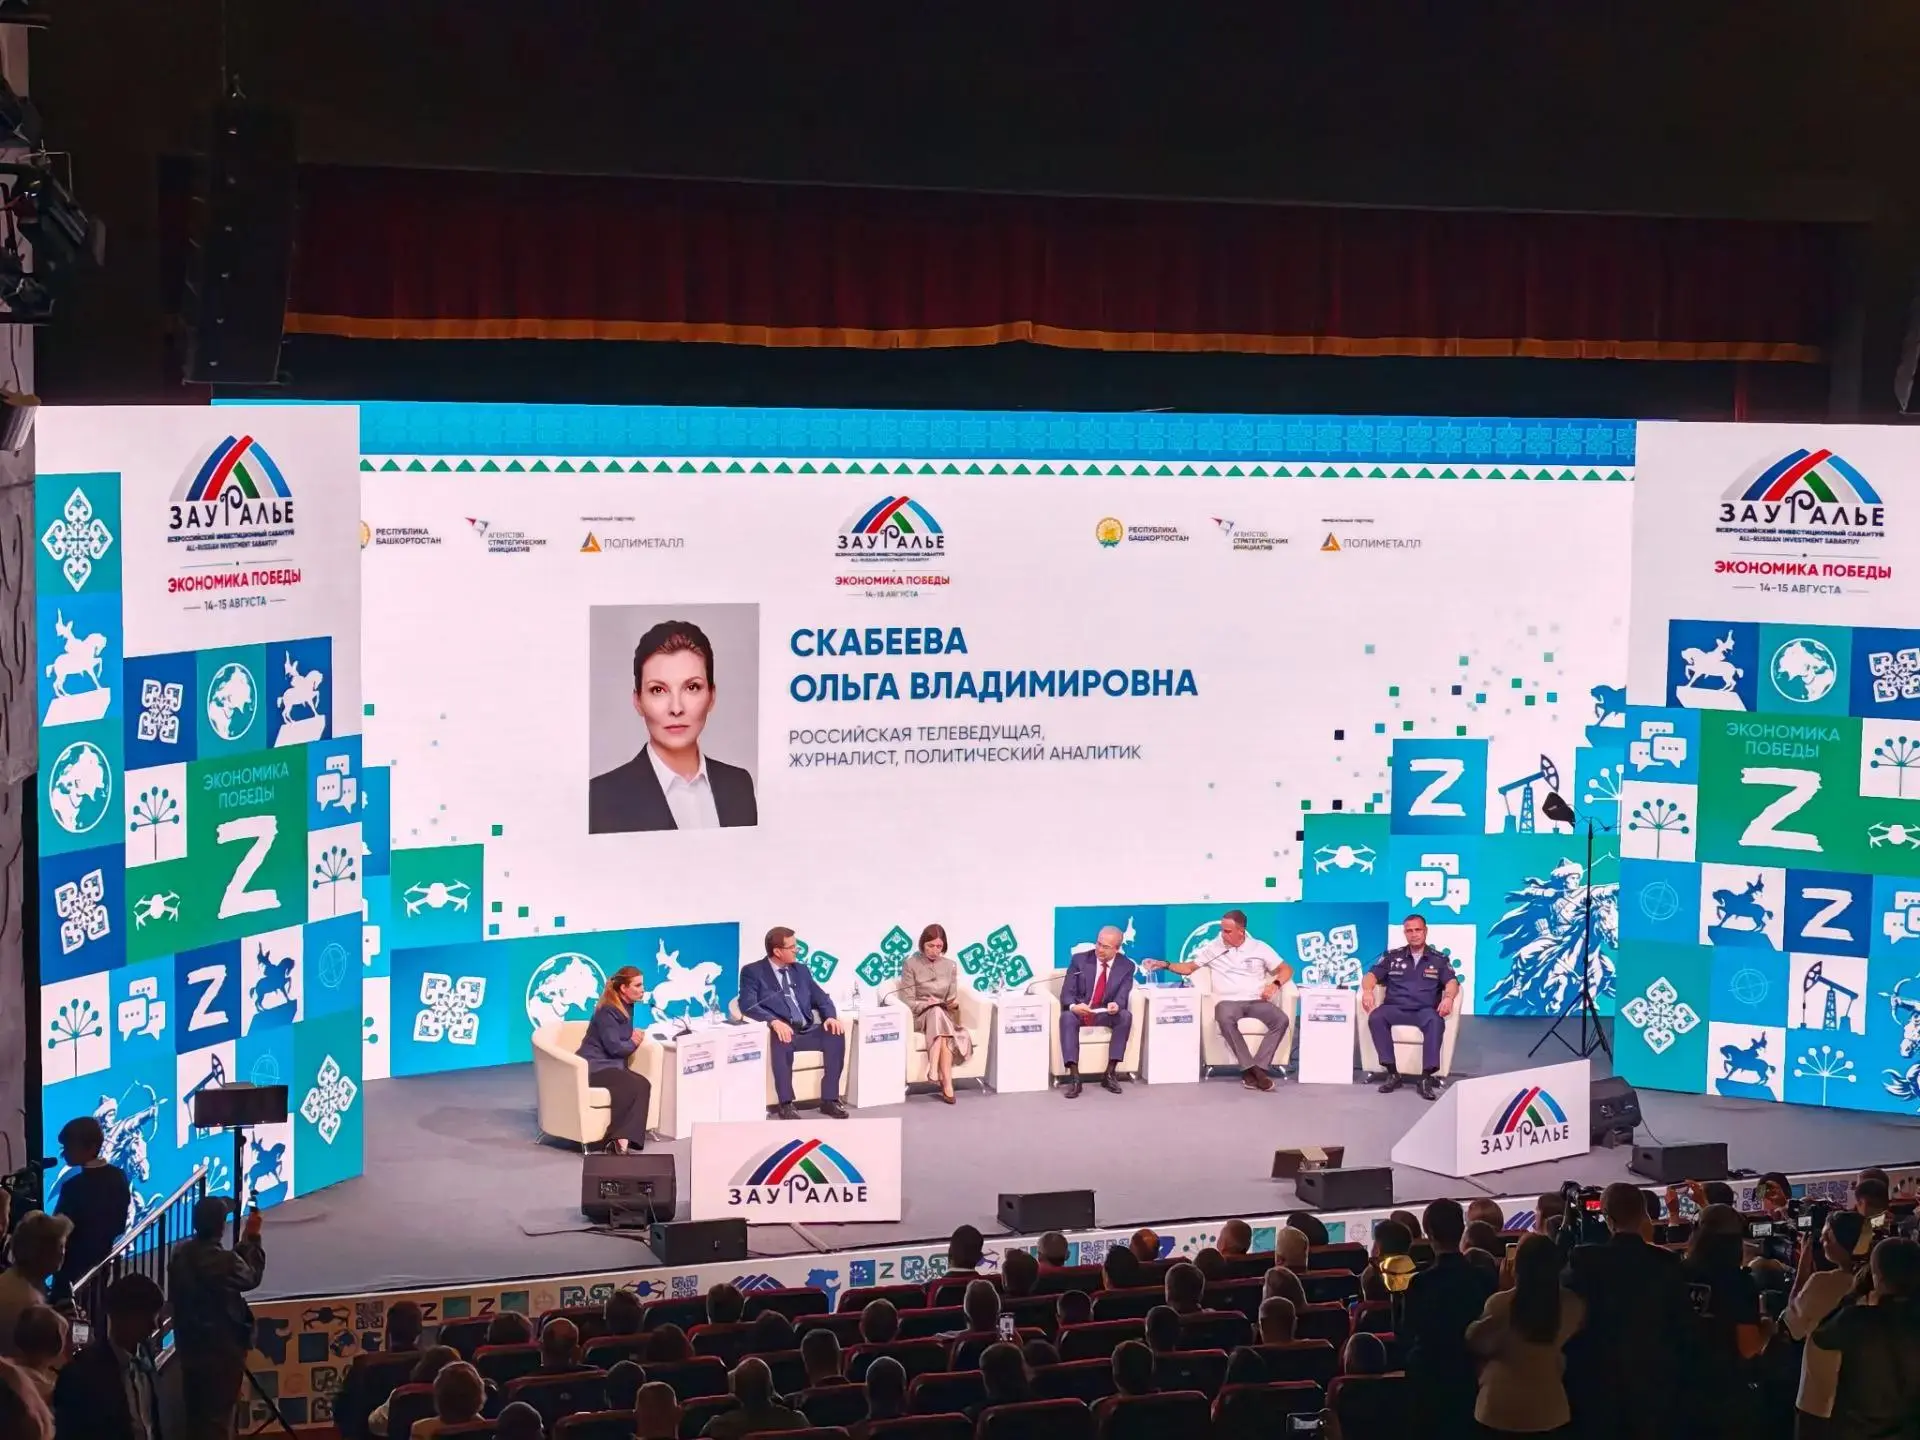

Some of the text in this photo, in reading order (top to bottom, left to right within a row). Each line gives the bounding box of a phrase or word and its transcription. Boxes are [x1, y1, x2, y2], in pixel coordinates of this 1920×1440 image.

[169, 484, 294, 530] ЗАУРАЛЬЕ
[1719, 490, 1884, 527] ЗАУРАЛЬЕ
[375, 528, 429, 536] РЕСПУБЛИКА
[375, 537, 442, 545] БАШКОРТОСТАН
[837, 525, 945, 549] ЗАУРАЛЬЕ
[1128, 534, 1189, 542] БАШКОРТОСТАН
[1715, 527, 1777, 535] ВСЕРОССИЙСКИЙ
[1739, 535, 1782, 543] ALL-RUSSIAN
[1783, 536, 1824, 544] INVESTMENT
[604, 538, 684, 548] ПОЛИМЕТАЛЛ
[1344, 539, 1422, 548] ПОЛИМЕТАЛЛ
[168, 568, 301, 593] ЭКОНОМИКА ПОБЕДЫ
[835, 576, 950, 586] ЭКОНОМИКА ПОБЕДЫ
[1714, 560, 1892, 580] ЭКОНОМИКА ПОБЕДЫ
[1791, 584, 1842, 595] АВГУСТА
[229, 596, 267, 608] АВГУСТА
[790, 627, 968, 657] СКАБЕЕВА
[789, 669, 1199, 704] ОЛЬГА ВЛАДИМИРОВНА
[789, 724, 1045, 744] РОССИЙСКАЯ ТЕЛЕВЕДУЩАЯ,
[1726, 721, 1841, 743] ЭКОНОМИКА
[788, 745, 1142, 767] ЖУРНАЛИСТ, ПОЛИТИЧЕСКИЙ АНАЛИТИК
[1744, 740, 1820, 760] ПОБЕДЫ
[203, 761, 290, 792] ЭКОНОМИКА
[1408, 758, 1466, 817] Z
[218, 784, 275, 809] ПОБЕДЫ
[1738, 766, 1824, 852] Z
[216, 815, 281, 919] Z
[1801, 887, 1854, 942] Z
[186, 964, 229, 1032] Z
[1480, 1119, 1570, 1155] ЗАУРАЛЬЕ
[728, 1174, 868, 1206] ЗАУРАЛЬЕ
